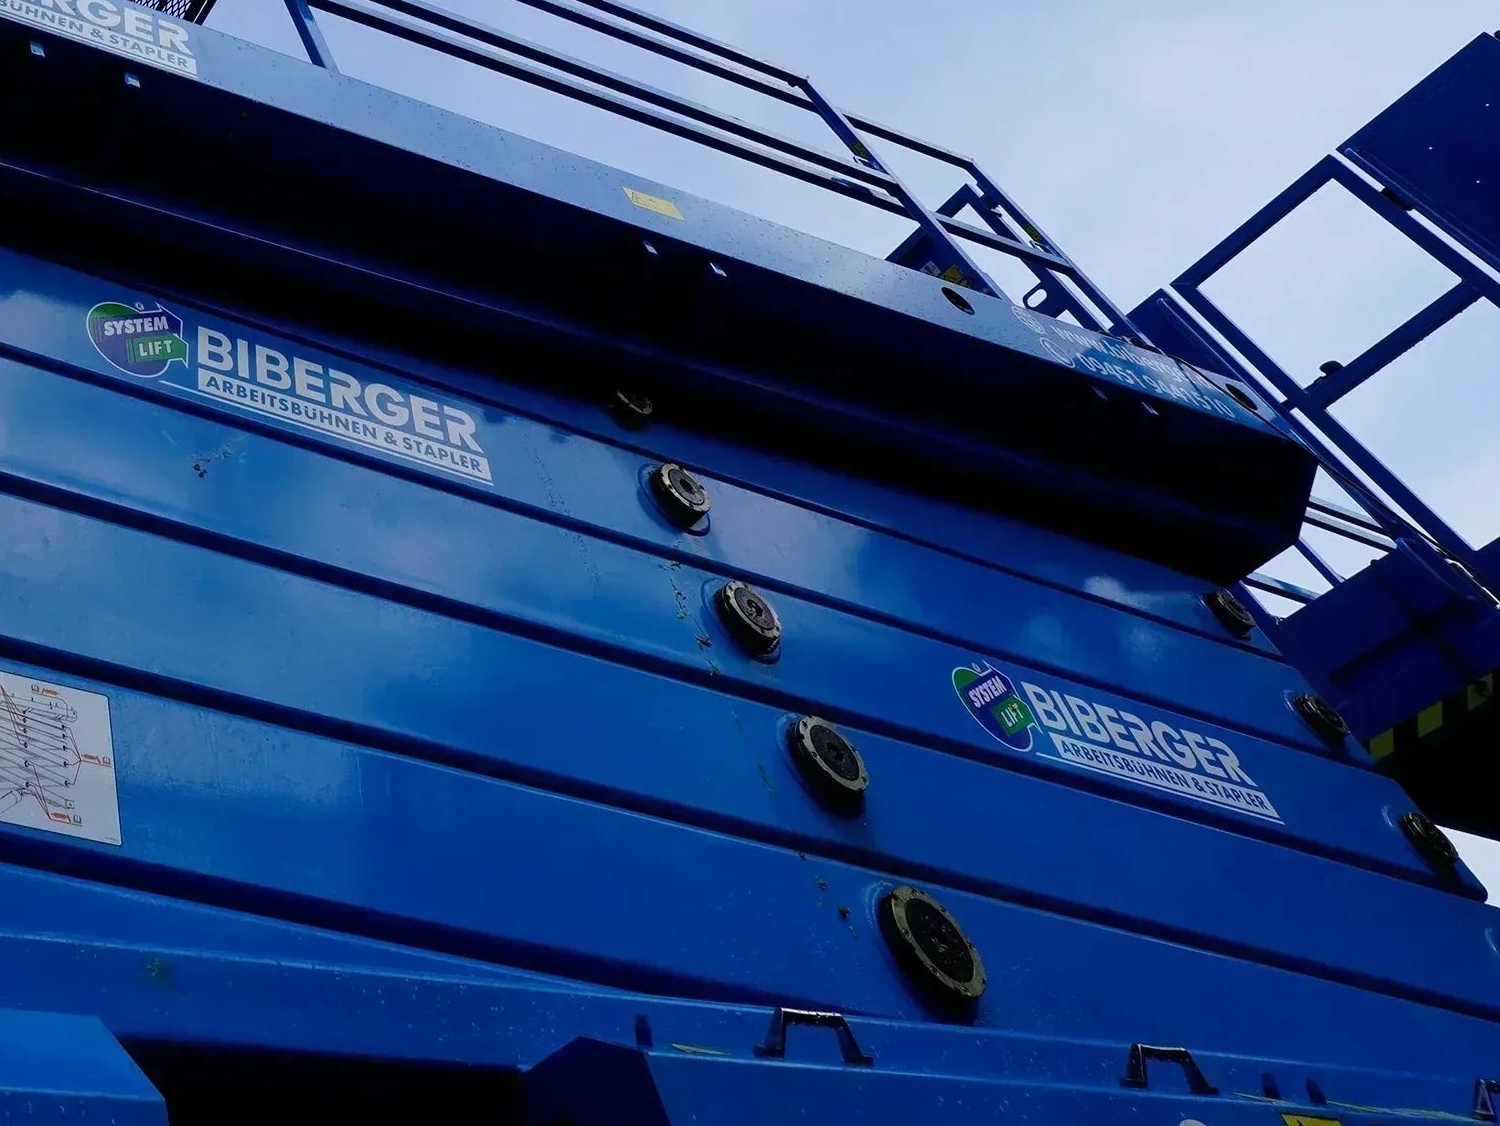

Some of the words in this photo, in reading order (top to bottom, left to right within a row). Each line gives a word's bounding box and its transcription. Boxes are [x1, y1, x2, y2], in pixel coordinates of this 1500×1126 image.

[89, 26, 105, 42] &
[108, 33, 189, 69] STAPLER
[103, 316, 169, 336] SYSTEM
[138, 340, 173, 357] LIFT
[1075, 352, 1148, 388] 09451
[198, 326, 484, 454] BIBERGER
[205, 375, 378, 440] ARBEITSBÜHNEN
[384, 431, 399, 446] &
[403, 437, 483, 474] STAPLER
[968, 675, 1007, 709] SYSTEM
[1000, 703, 1024, 728] LIFT
[1020, 681, 1261, 787] BIBERGER
[1060, 739, 1189, 790] ARBEITSBÜHNEN
[1192, 776, 1206, 793] &
[1205, 781, 1270, 812] STAPLER
